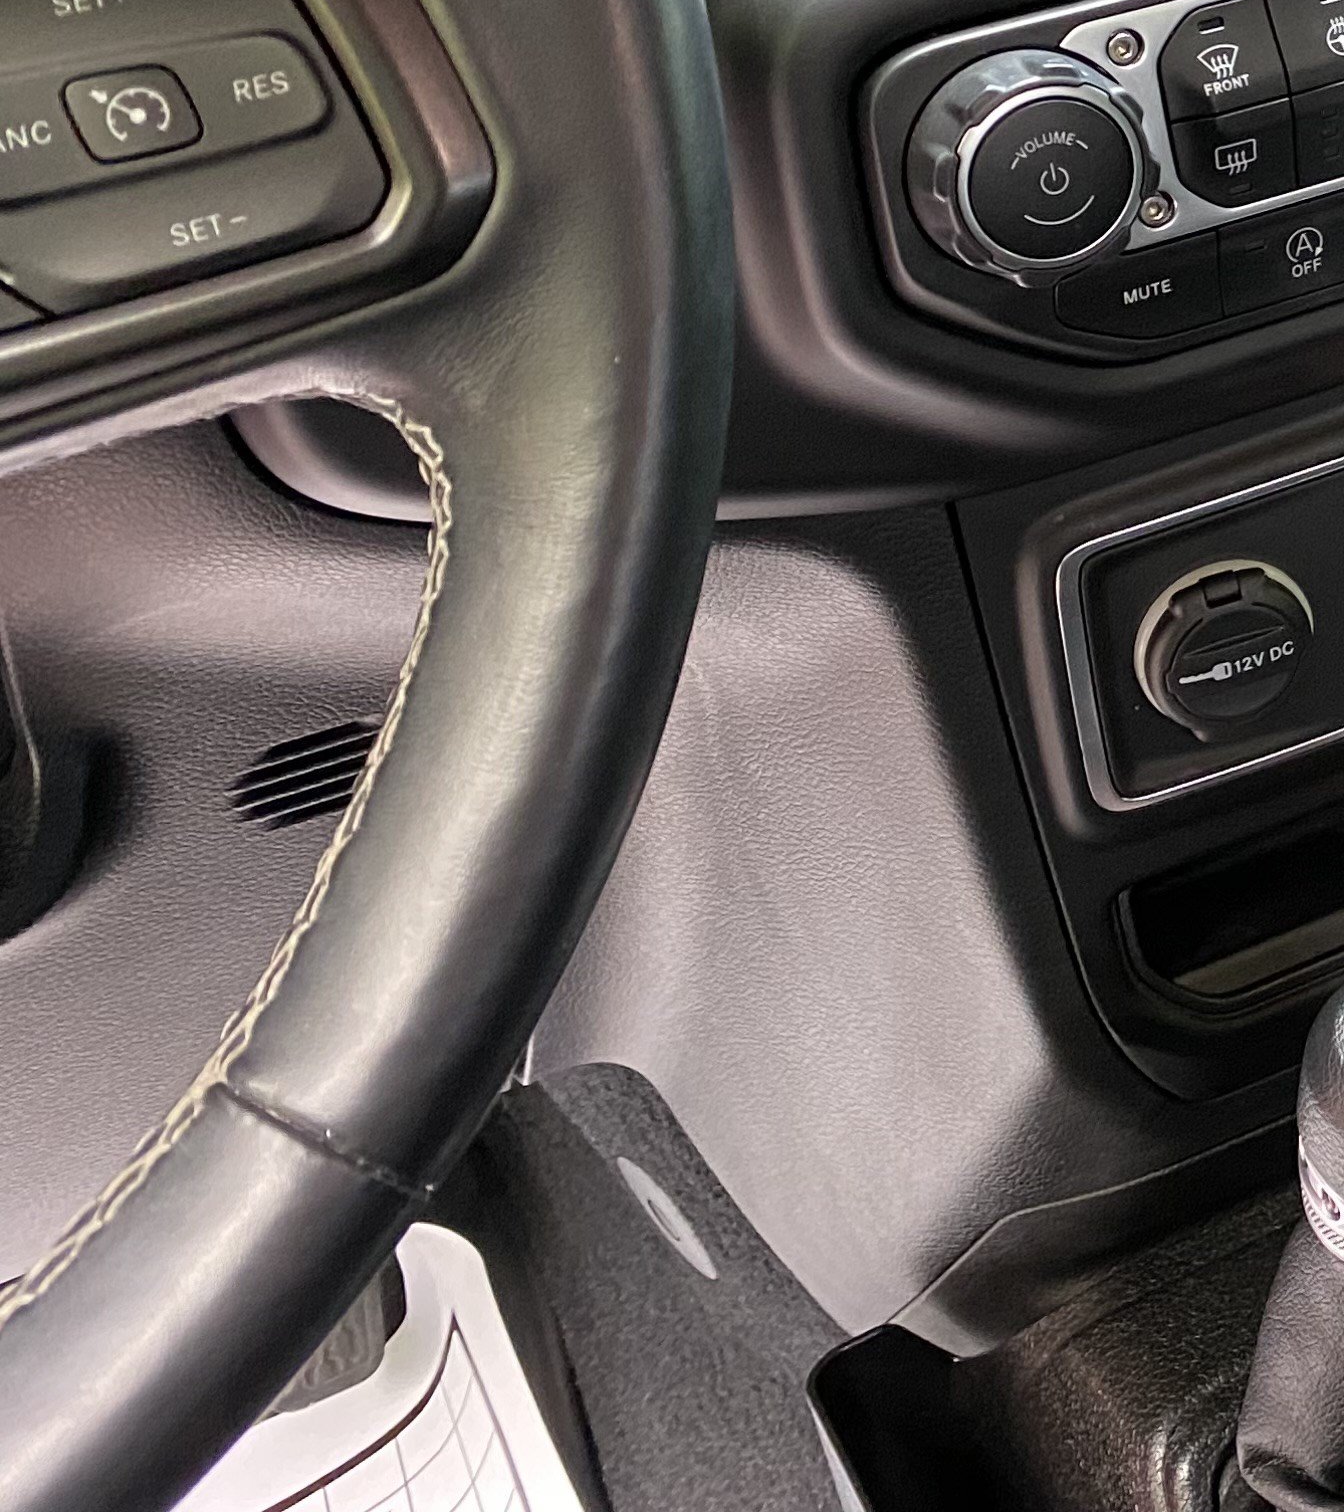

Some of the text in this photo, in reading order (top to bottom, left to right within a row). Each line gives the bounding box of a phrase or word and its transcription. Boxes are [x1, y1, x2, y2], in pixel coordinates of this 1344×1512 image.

[232, 70, 290, 104] RES
[1203, 73, 1250, 97] FRONT
[1016, 130, 1076, 161] VOLUME
[1291, 257, 1323, 278] OFF
[1123, 278, 1172, 305] MUTE
[1234, 641, 1295, 673] 12V DC
